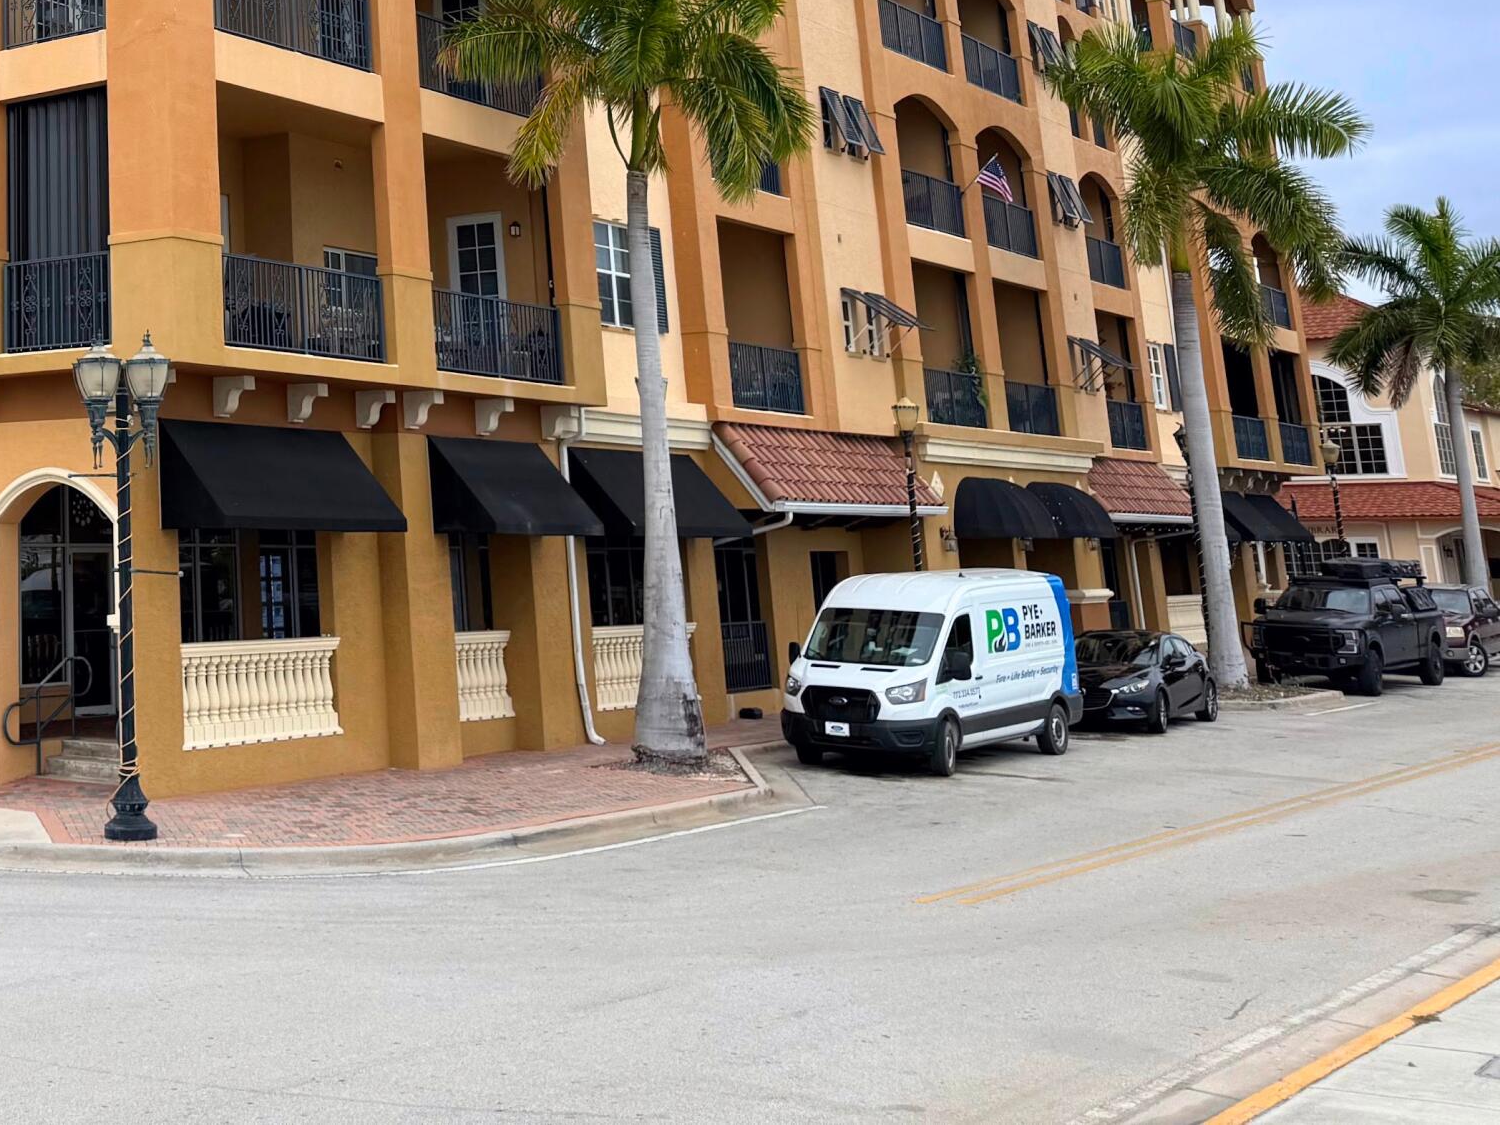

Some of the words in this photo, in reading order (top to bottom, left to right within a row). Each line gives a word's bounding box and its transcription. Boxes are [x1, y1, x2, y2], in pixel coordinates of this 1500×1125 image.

[1024, 621, 1056, 640] BARKER
[1010, 672, 1020, 681] Life
[1021, 669, 1036, 679] Safety
[1040, 665, 1058, 675] Security
